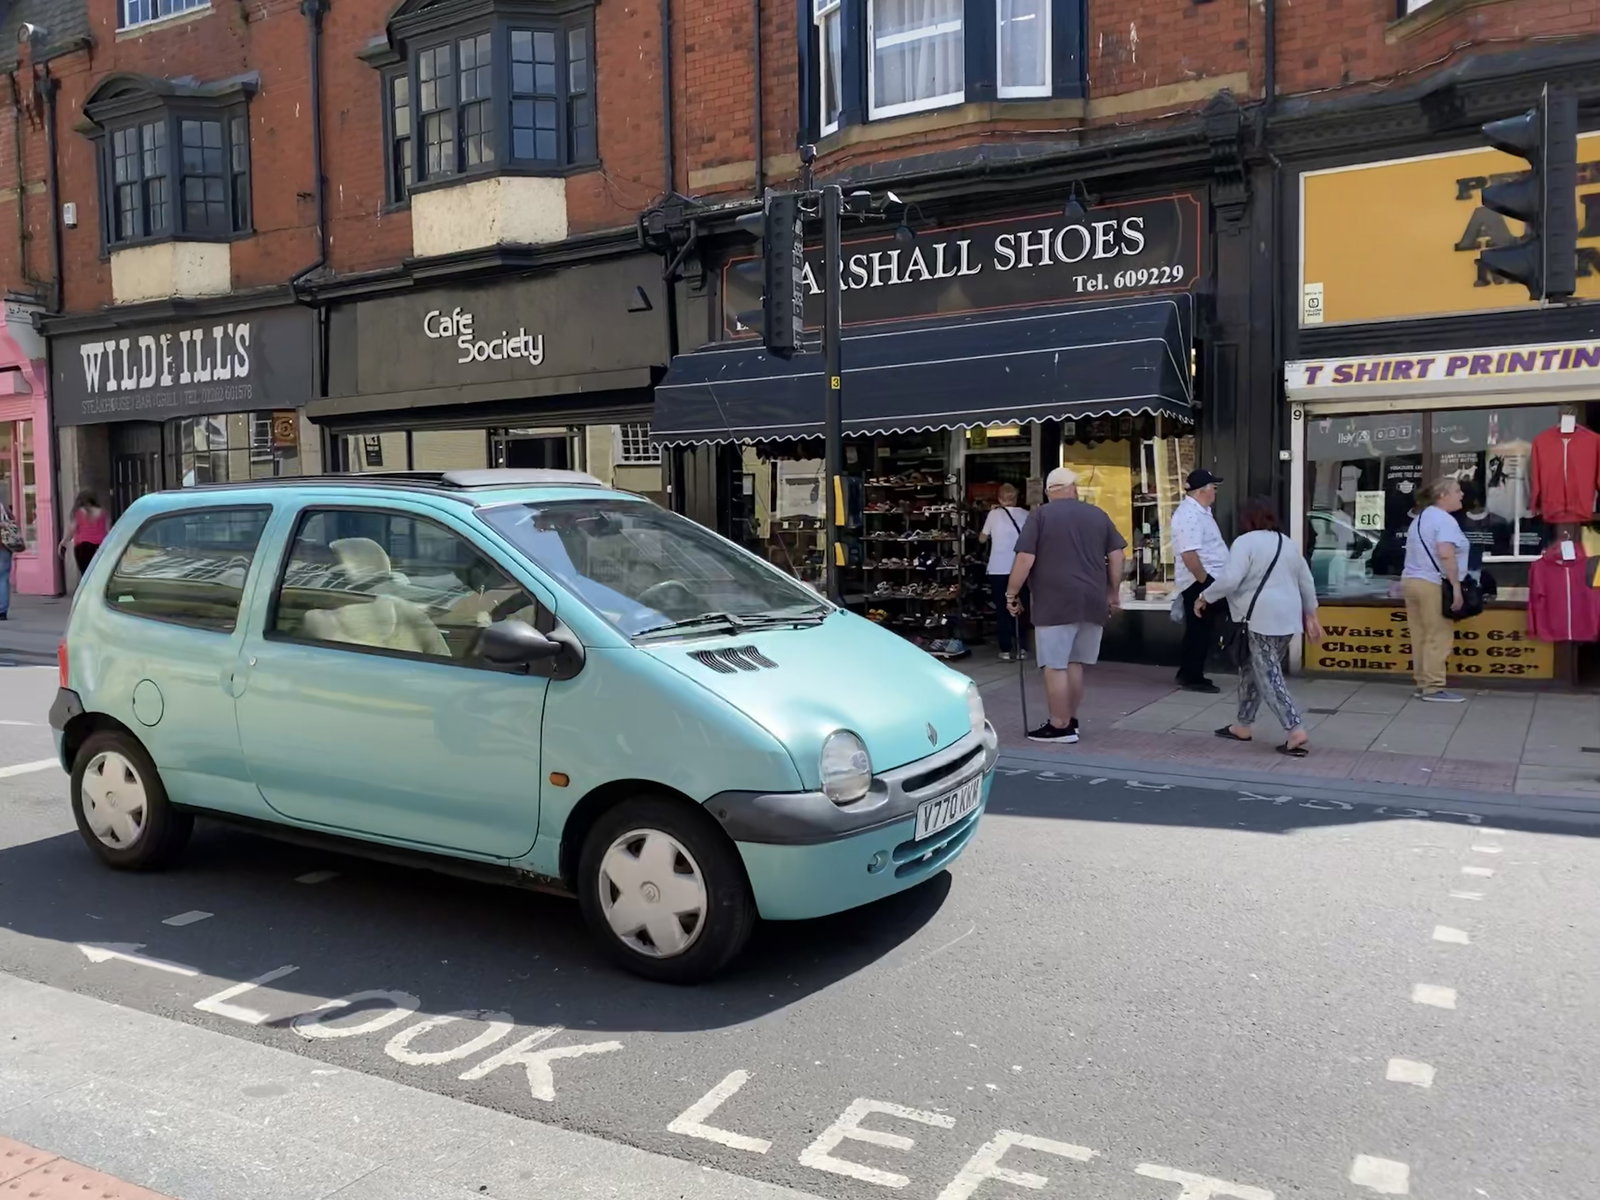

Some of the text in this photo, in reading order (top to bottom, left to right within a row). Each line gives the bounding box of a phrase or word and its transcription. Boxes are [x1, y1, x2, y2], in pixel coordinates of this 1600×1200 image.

[993, 216, 1146, 272] SHOES
[1072, 264, 1185, 293] Tel. 609229
[423, 306, 473, 338] Cafe
[457, 327, 544, 366] Society
[1304, 346, 1600, 385] T SHIRT PRINTIN
[832, 377, 839, 388] 3
[1293, 409, 1302, 421] 9
[1322, 625, 1394, 638] Waist
[1321, 641, 1392, 654] Chest
[1452, 646, 1480, 657] to
[1318, 656, 1397, 671] Collar
[1455, 663, 1482, 674] to
[924, 791, 959, 833] V770
[193, 963, 625, 1102] LOOK
